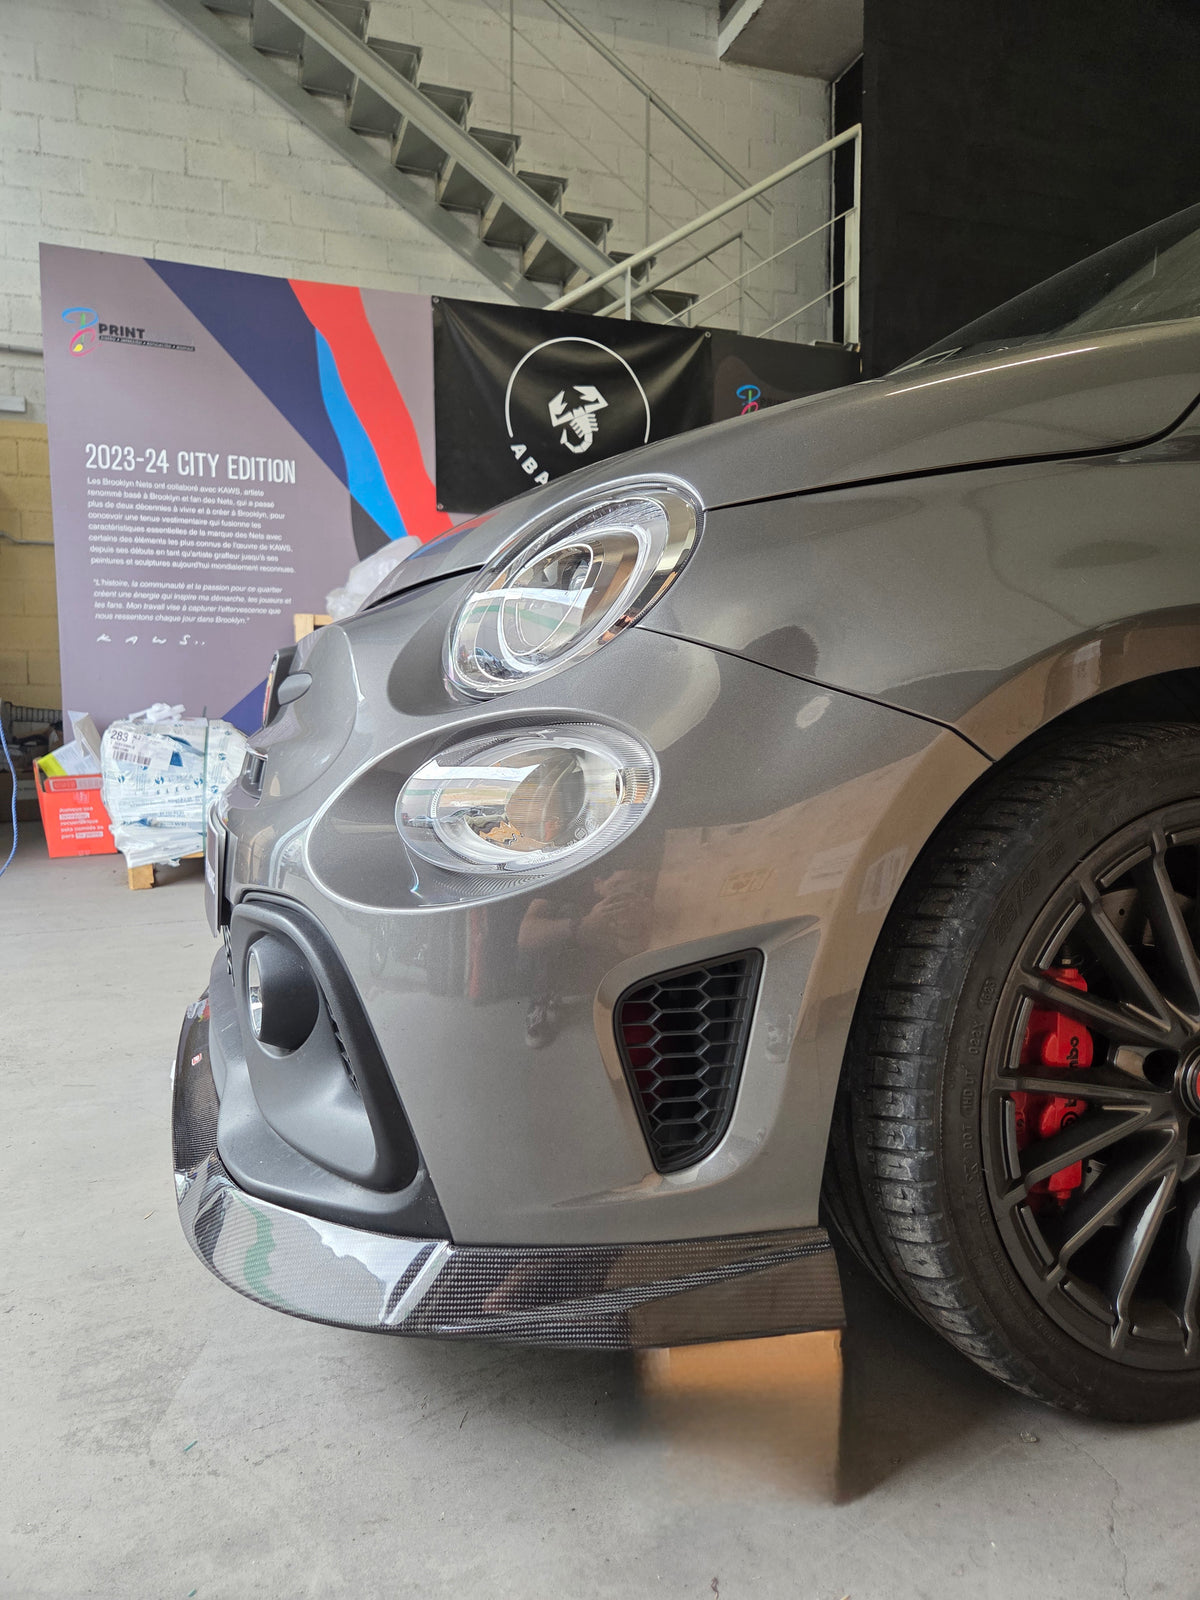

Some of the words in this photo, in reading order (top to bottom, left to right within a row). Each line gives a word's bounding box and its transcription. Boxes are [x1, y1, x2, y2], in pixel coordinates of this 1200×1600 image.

[99, 324, 145, 338] PRINT
[86, 443, 170, 474] 2023-24
[177, 451, 220, 478] CITY
[227, 454, 296, 484] EDITION
[87, 476, 101, 485] Les
[102, 478, 135, 488] Brooklyn
[135, 480, 153, 488] Nets
[166, 482, 198, 491] collaboré
[218, 486, 242, 496] KAWS,
[243, 488, 264, 496] artiste
[87, 489, 122, 498] renommé
[123, 490, 142, 499] basé
[149, 492, 181, 503] Brooklyn
[203, 496, 216, 504] des
[216, 496, 234, 506] Nets,
[254, 500, 275, 508] passé
[88, 500, 103, 508] plus
[104, 500, 114, 509] de
[116, 502, 134, 510] deux
[135, 502, 172, 512] décennies
[179, 506, 196, 514] vivre
[212, 508, 230, 516] créer
[237, 510, 268, 520] Brooklyn,
[270, 512, 285, 520] pour
[88, 512, 124, 520] concevoir
[162, 516, 208, 525] vestimentaire
[209, 520, 220, 528] qui
[221, 520, 250, 528] fusionne
[88, 523, 145, 533] caractéristiques
[146, 526, 187, 535] essentielles
[188, 528, 198, 536] de
[207, 530, 234, 538] marque
[234, 531, 248, 539] des
[248, 531, 264, 540] Nets
[88, 534, 118, 542] certains
[134, 536, 166, 544] éléments
[168, 538, 178, 546] les
[180, 539, 194, 547] plus
[196, 540, 221, 548] connus
[259, 542, 268, 550] de
[89, 545, 114, 554] depuis
[130, 546, 154, 555] débuts
[166, 548, 180, 556] tant
[214, 552, 240, 560] graffeur
[90, 556, 124, 565] peintures
[134, 558, 170, 568] sculptures
[211, 562, 258, 572] mondialement
[131, 580, 138, 588] la
[140, 580, 185, 590] communauté
[186, 582, 194, 590] et
[194, 582, 202, 590] la
[202, 584, 230, 592] passion
[257, 586, 283, 594] quartier
[93, 590, 116, 598] créent
[133, 591, 160, 601] énergie
[161, 592, 173, 601] qui
[174, 592, 197, 601] inspire
[94, 601, 105, 609] les
[106, 601, 124, 609] fans.
[126, 602, 142, 610] Mon
[144, 602, 165, 610] travail
[166, 603, 180, 611] vise
[188, 604, 217, 613] capturer
[95, 612, 113, 620] nous
[155, 614, 181, 622] chaque
[181, 616, 196, 624] jour
[110, 730, 129, 743] 283
